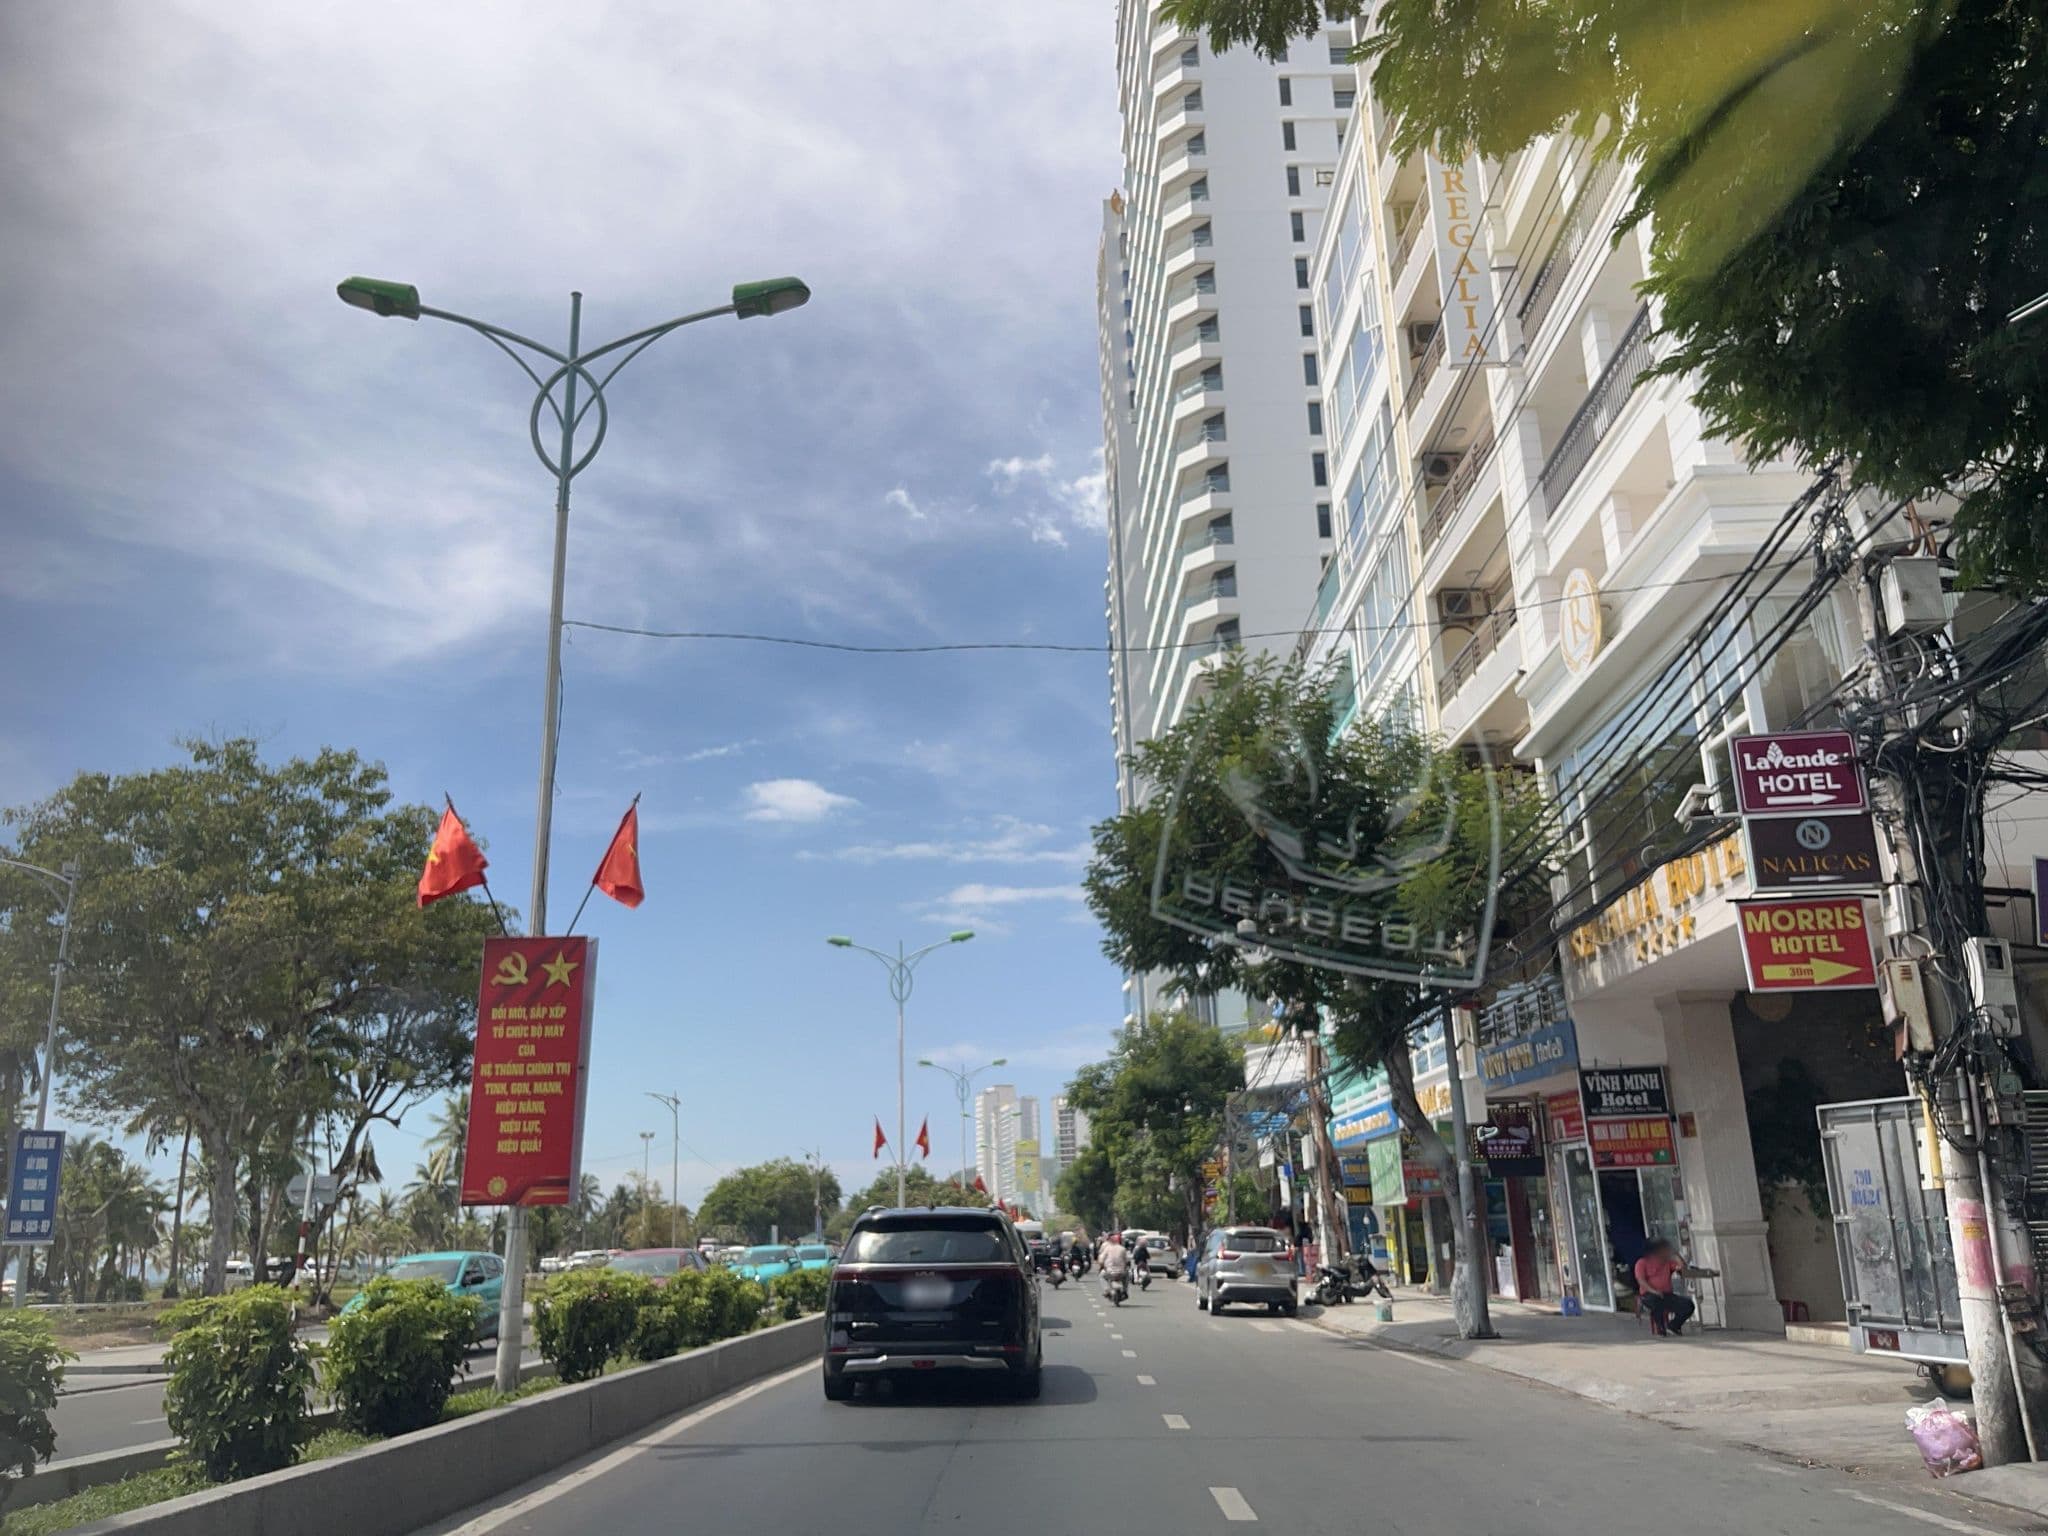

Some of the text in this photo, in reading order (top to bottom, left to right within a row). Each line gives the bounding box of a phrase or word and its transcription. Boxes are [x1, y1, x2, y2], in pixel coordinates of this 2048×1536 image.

[1442, 170, 1488, 357] REGALIA
[1758, 772, 1842, 794] HOTEL
[1665, 838, 1746, 908] HOTE
[1763, 852, 1871, 874] NALICAS
[1744, 905, 1862, 933] MORRIS
[1770, 934, 1845, 954] HOTEL
[1623, 1073, 1660, 1091] MINH
[1601, 1091, 1649, 1107] Hotel
